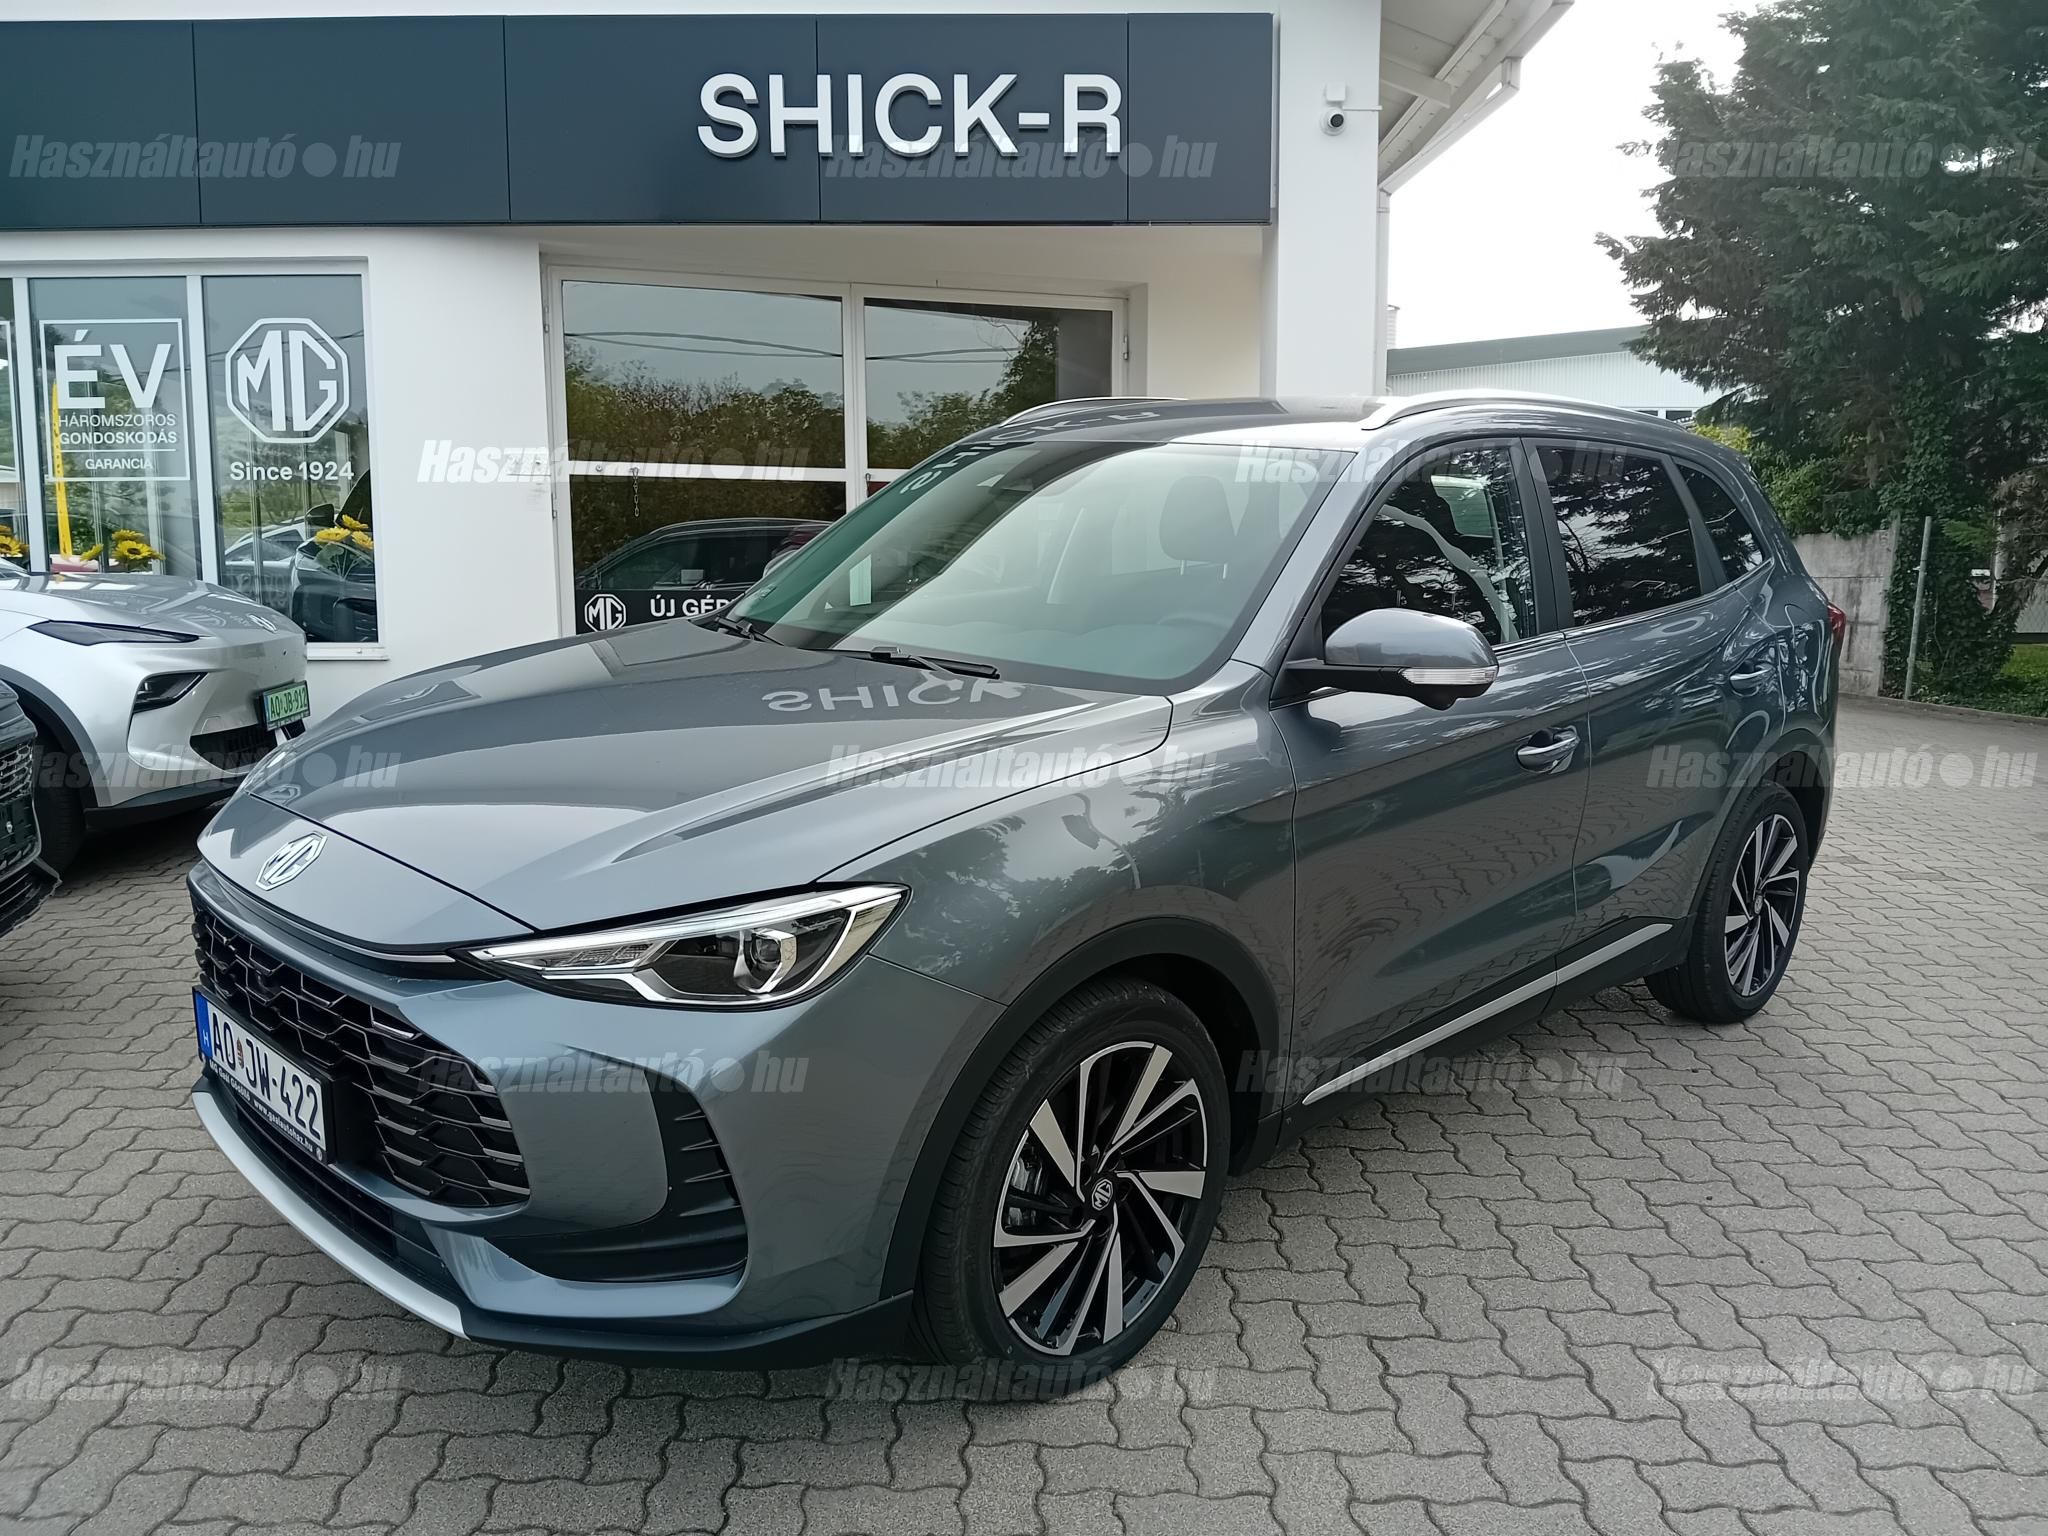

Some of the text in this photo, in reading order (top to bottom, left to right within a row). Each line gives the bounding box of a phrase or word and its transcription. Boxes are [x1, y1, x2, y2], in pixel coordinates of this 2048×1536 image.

[697, 73, 1122, 159] SHICK-R
[55, 329, 172, 409] ÉV
[236, 328, 338, 432] MG
[59, 413, 177, 428] HÁROMSZOROS
[60, 430, 177, 446] GONDOSKODÁS
[85, 457, 153, 470] GARANCIA
[230, 461, 354, 481] Since 1924
[650, 594, 676, 617] ÚJ
[203, 1029, 210, 1048] H
